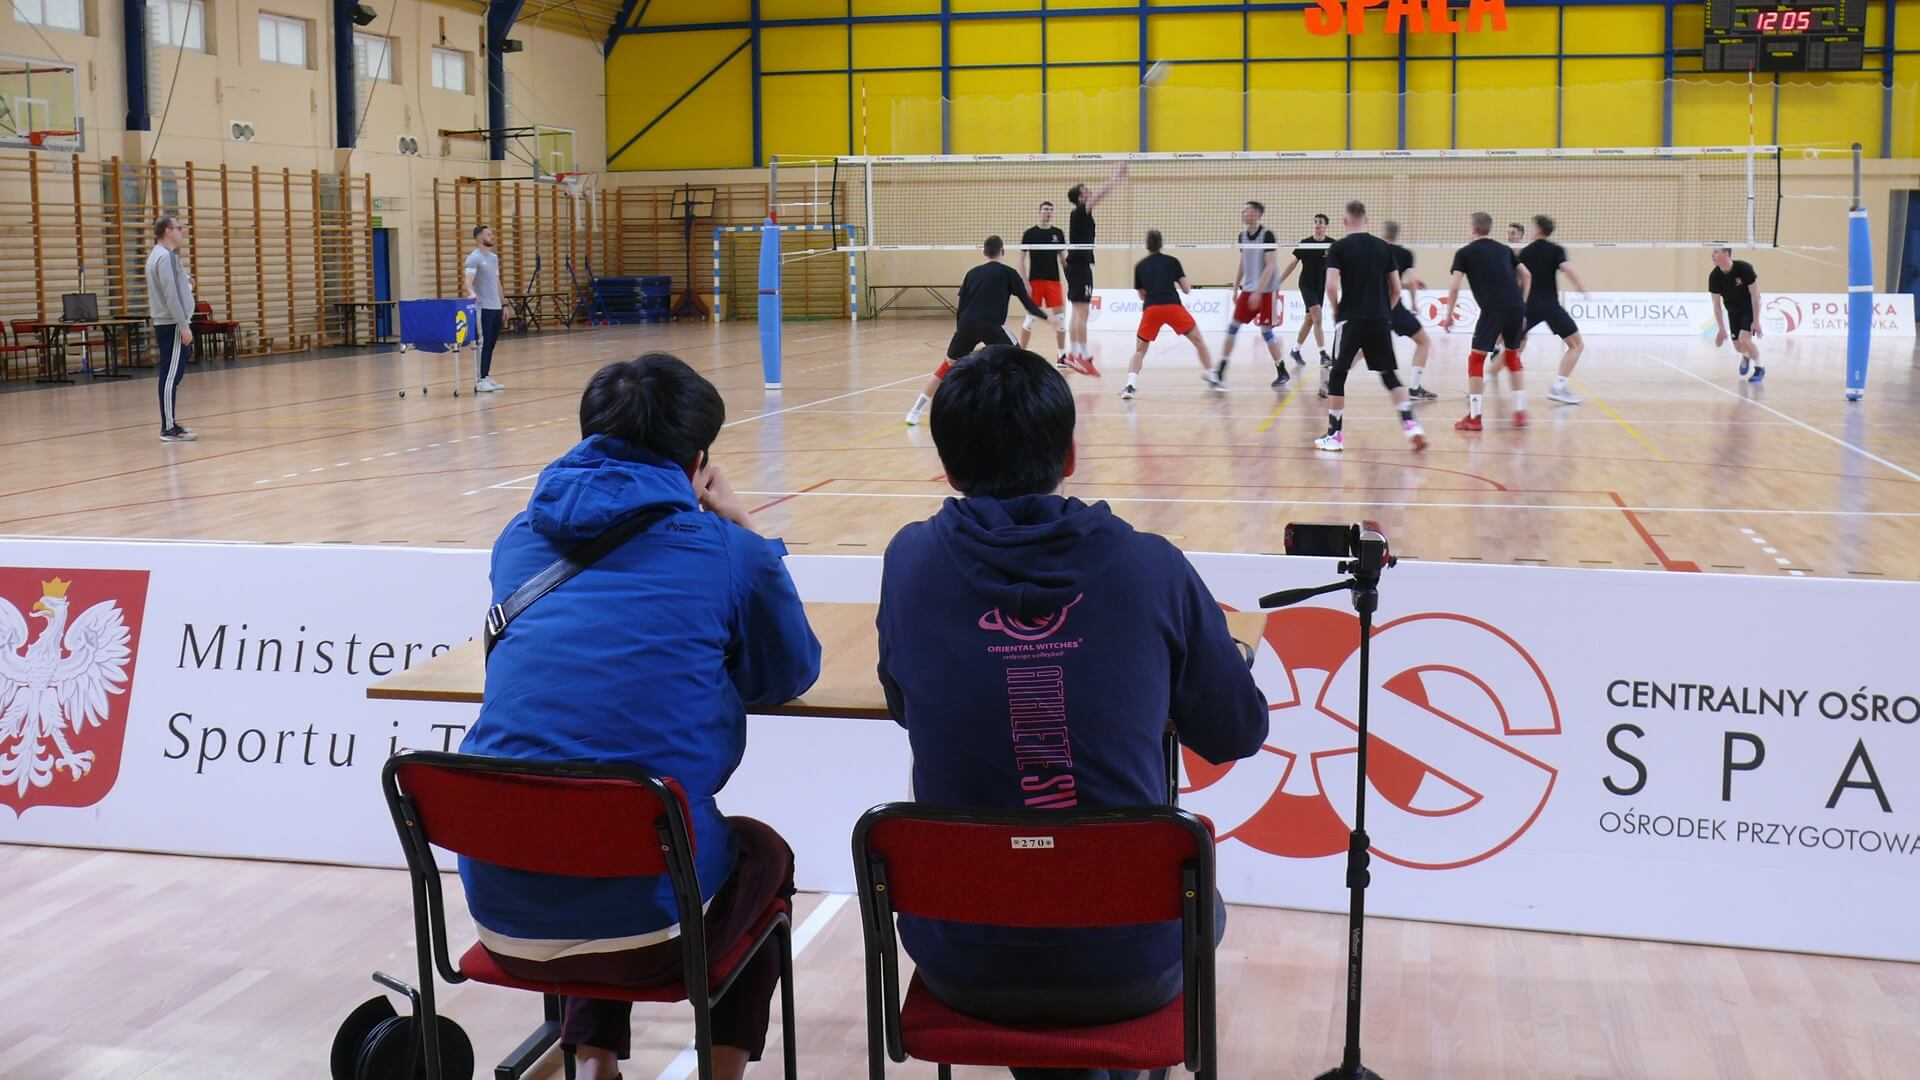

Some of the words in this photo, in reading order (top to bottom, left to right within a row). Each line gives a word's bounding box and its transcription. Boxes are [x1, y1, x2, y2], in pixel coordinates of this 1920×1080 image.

[1571, 304, 1689, 320] OLIMPIJSKA
[1812, 303, 1897, 315] POLKA
[1812, 319, 1899, 329] SIATKWKA
[987, 644, 1035, 654] ORIENTAL
[1606, 679, 1809, 717] CENTRALNY
[1818, 686, 1920, 724] OŚRO
[1006, 665, 1073, 771] ATHLETE
[163, 711, 356, 774] Sportu
[1599, 807, 1727, 841] OŚRODEK
